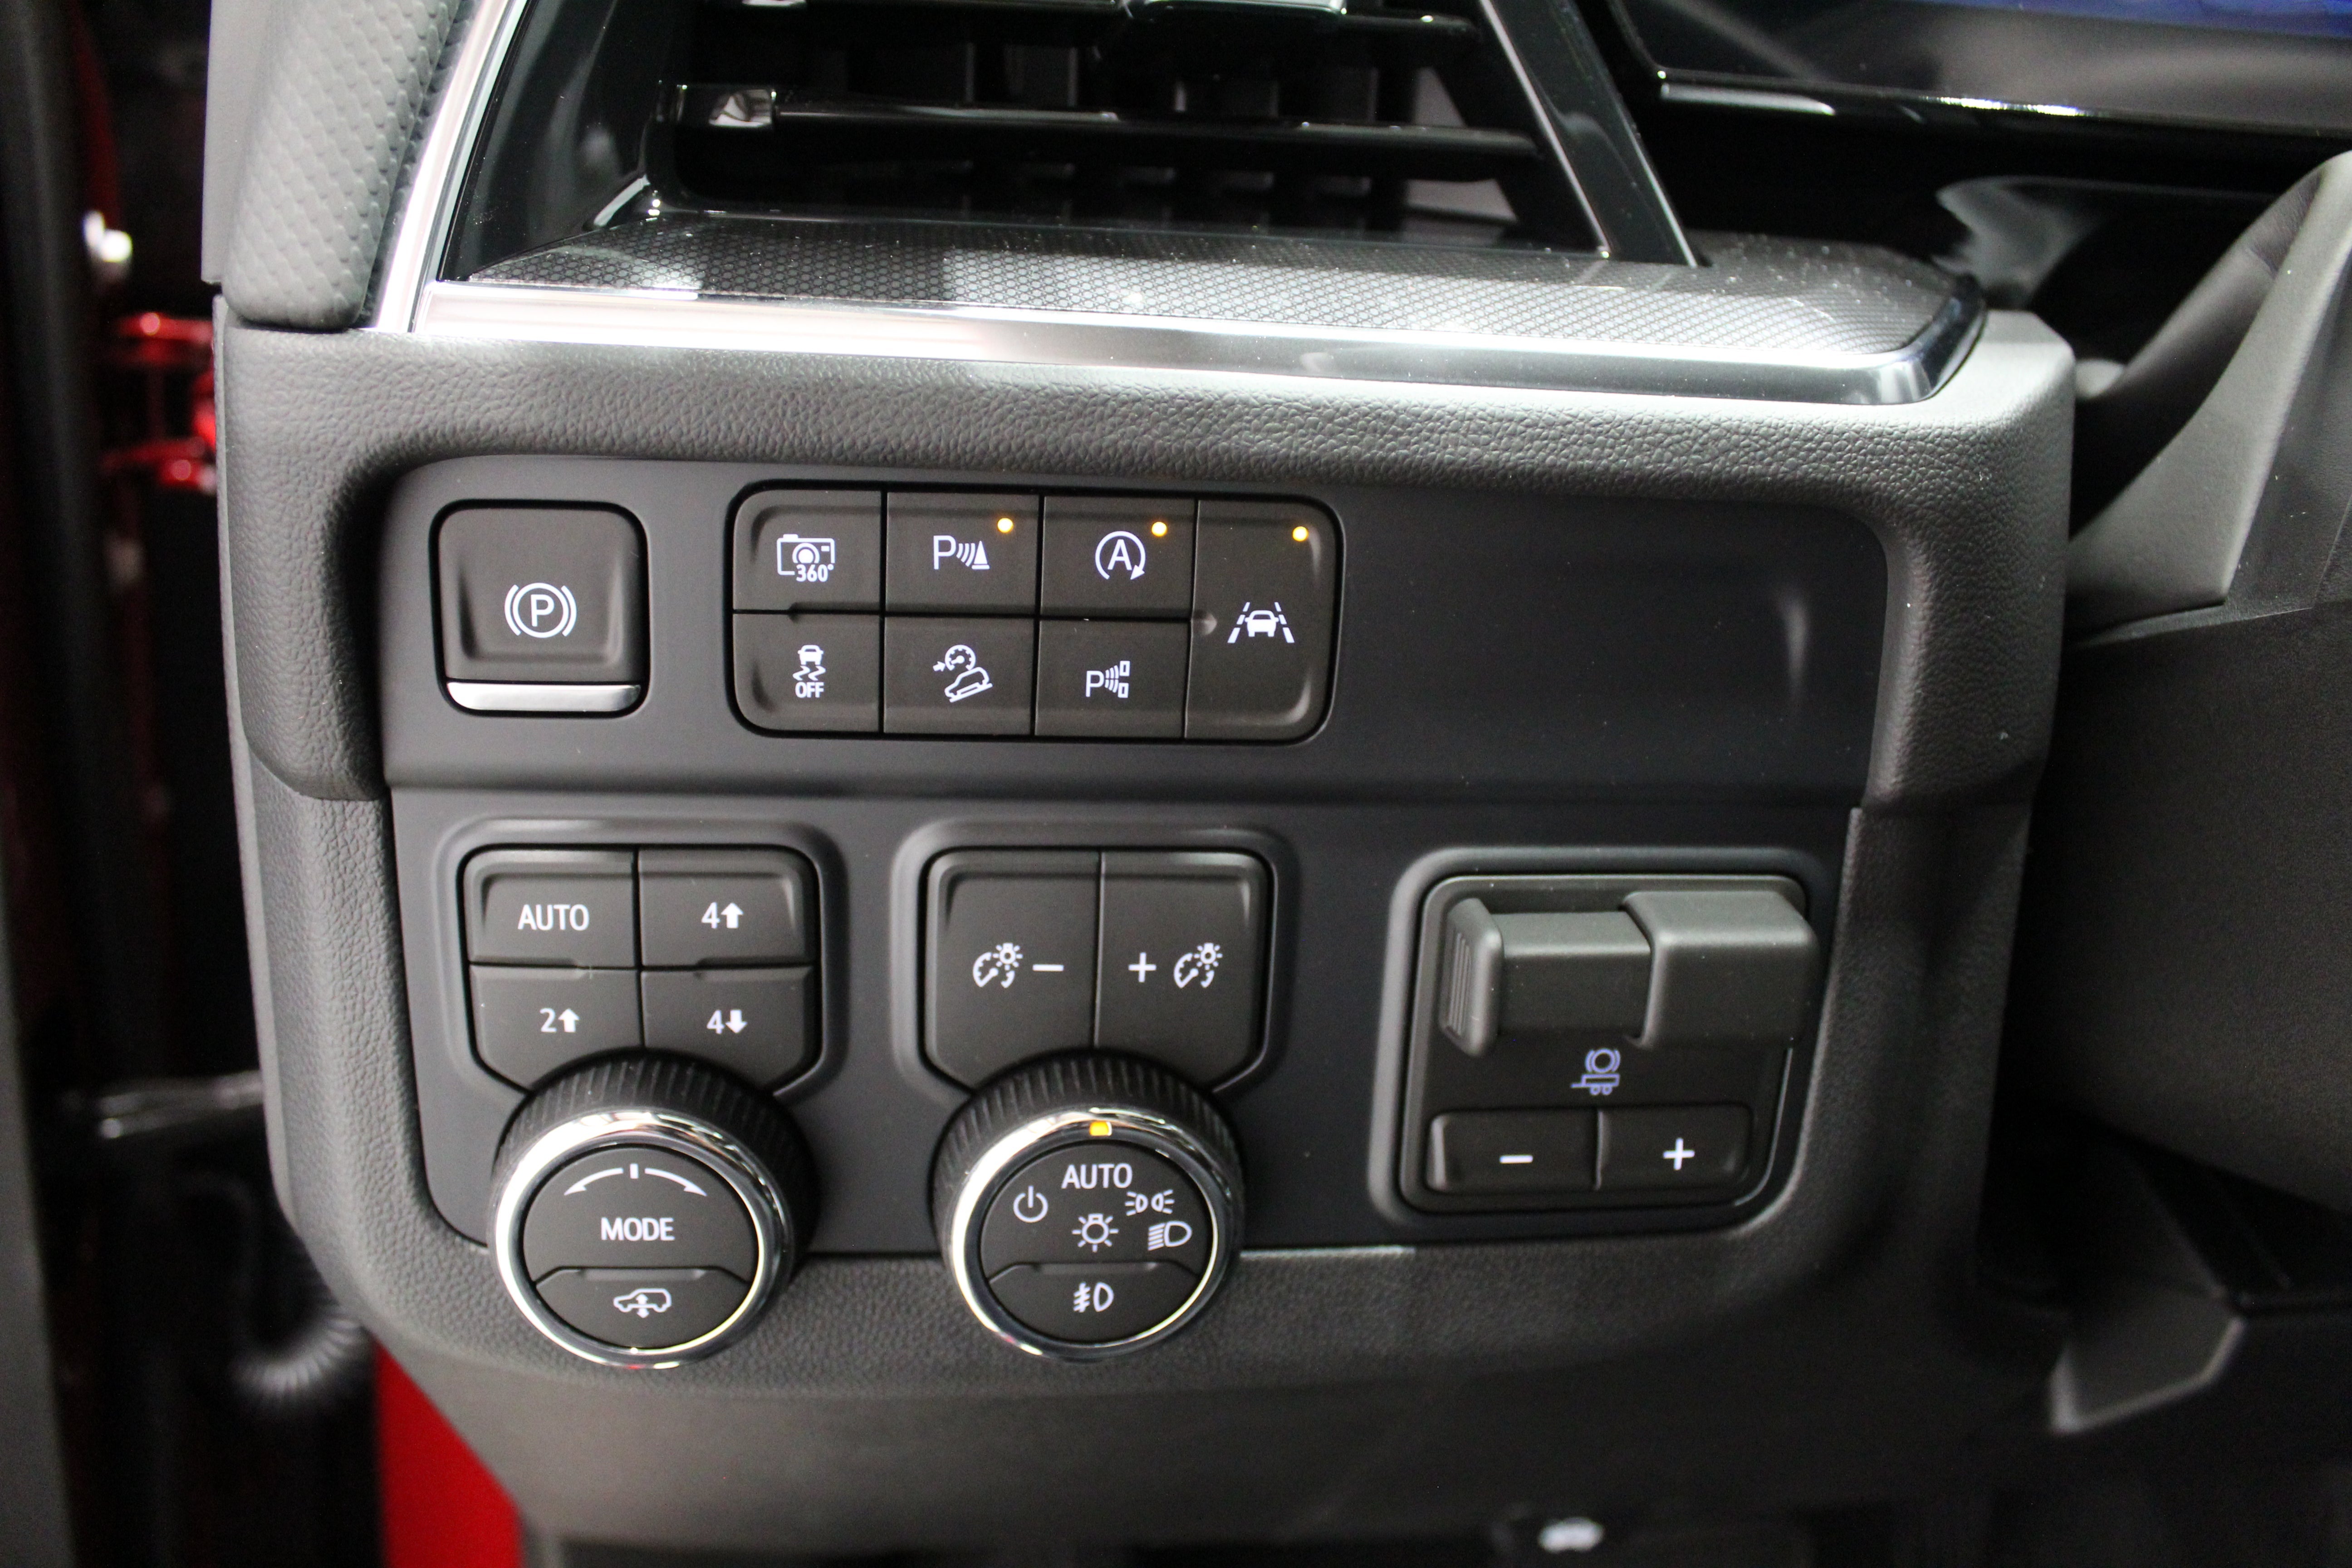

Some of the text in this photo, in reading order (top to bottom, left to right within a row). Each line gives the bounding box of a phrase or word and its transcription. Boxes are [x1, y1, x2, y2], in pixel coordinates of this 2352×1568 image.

[933, 535, 956, 570] P
[1107, 539, 1132, 570] A
[530, 594, 554, 627] P
[795, 681, 824, 698] OFF
[1086, 670, 1104, 697] P
[517, 904, 590, 931] AUTO
[701, 902, 720, 929] 4
[539, 1008, 557, 1033] 2
[706, 1010, 724, 1034] 4
[1061, 1163, 1133, 1189] AUTO
[600, 1217, 675, 1241] MODE
